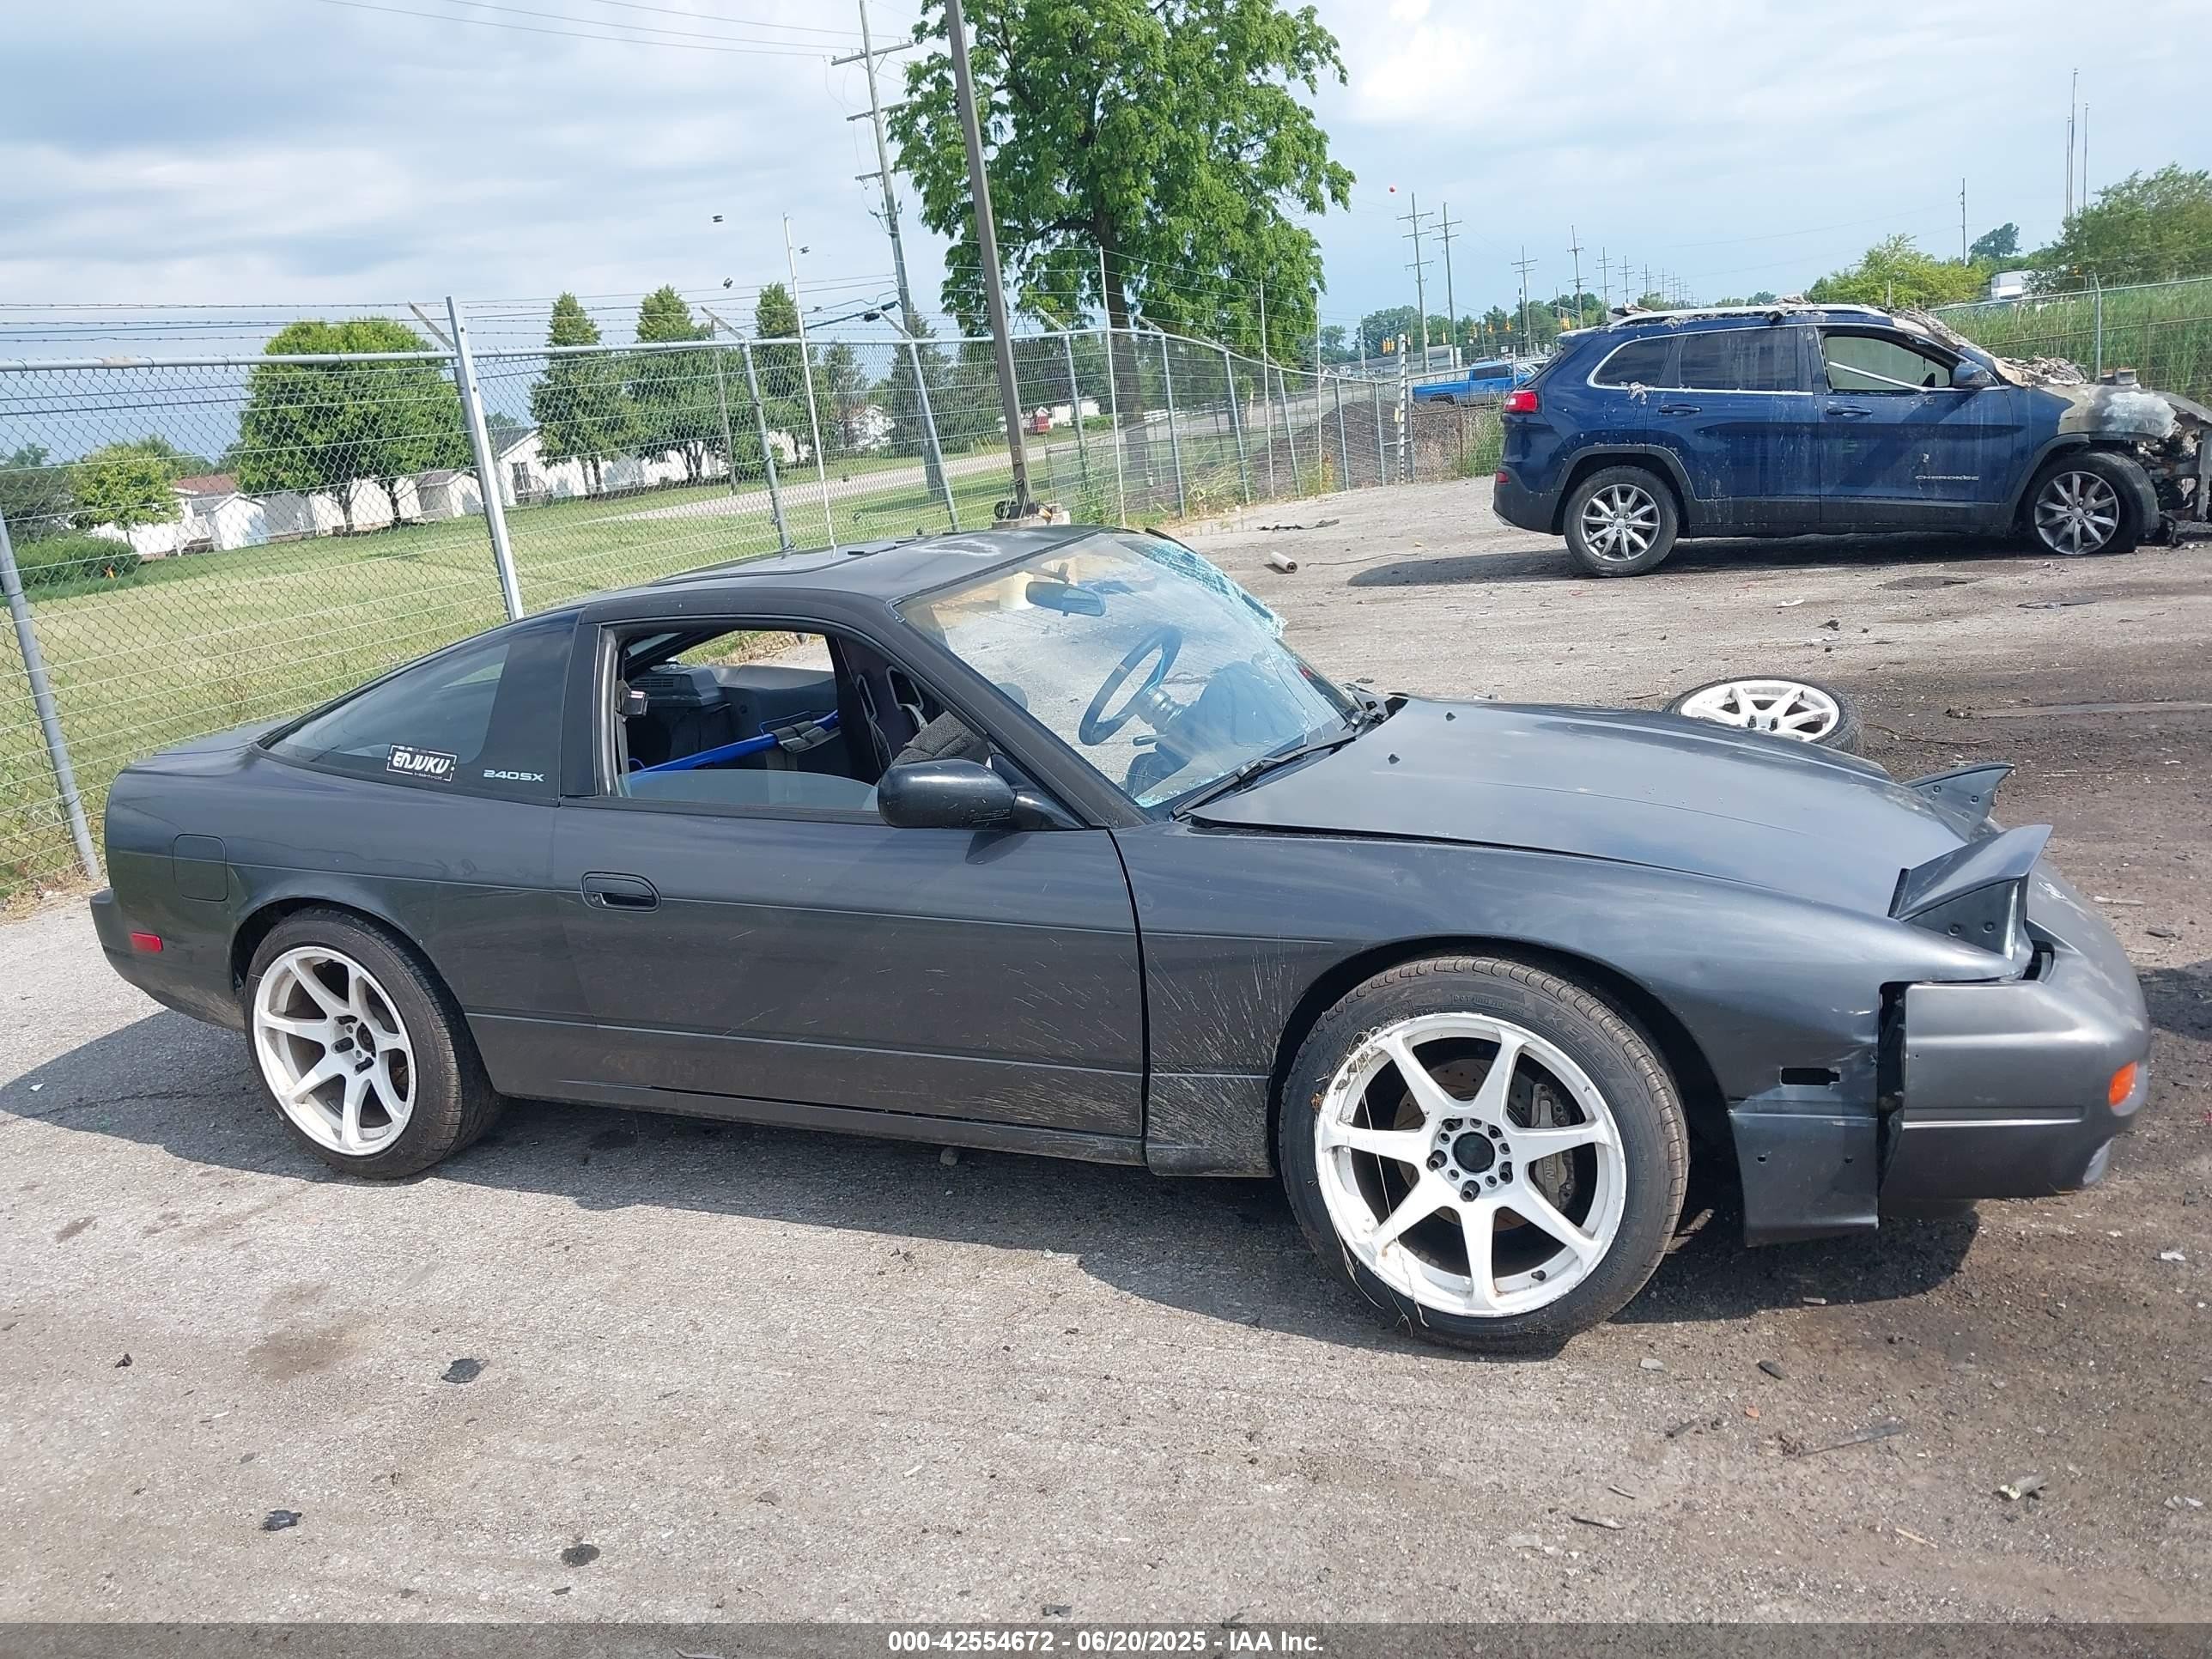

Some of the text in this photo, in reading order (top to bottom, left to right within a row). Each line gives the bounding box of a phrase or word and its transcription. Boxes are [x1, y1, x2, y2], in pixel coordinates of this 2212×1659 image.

[392, 750, 451, 775] ENJUKU
[483, 769, 544, 782] 240SX
[1543, 1012, 1620, 1072] KELLY
